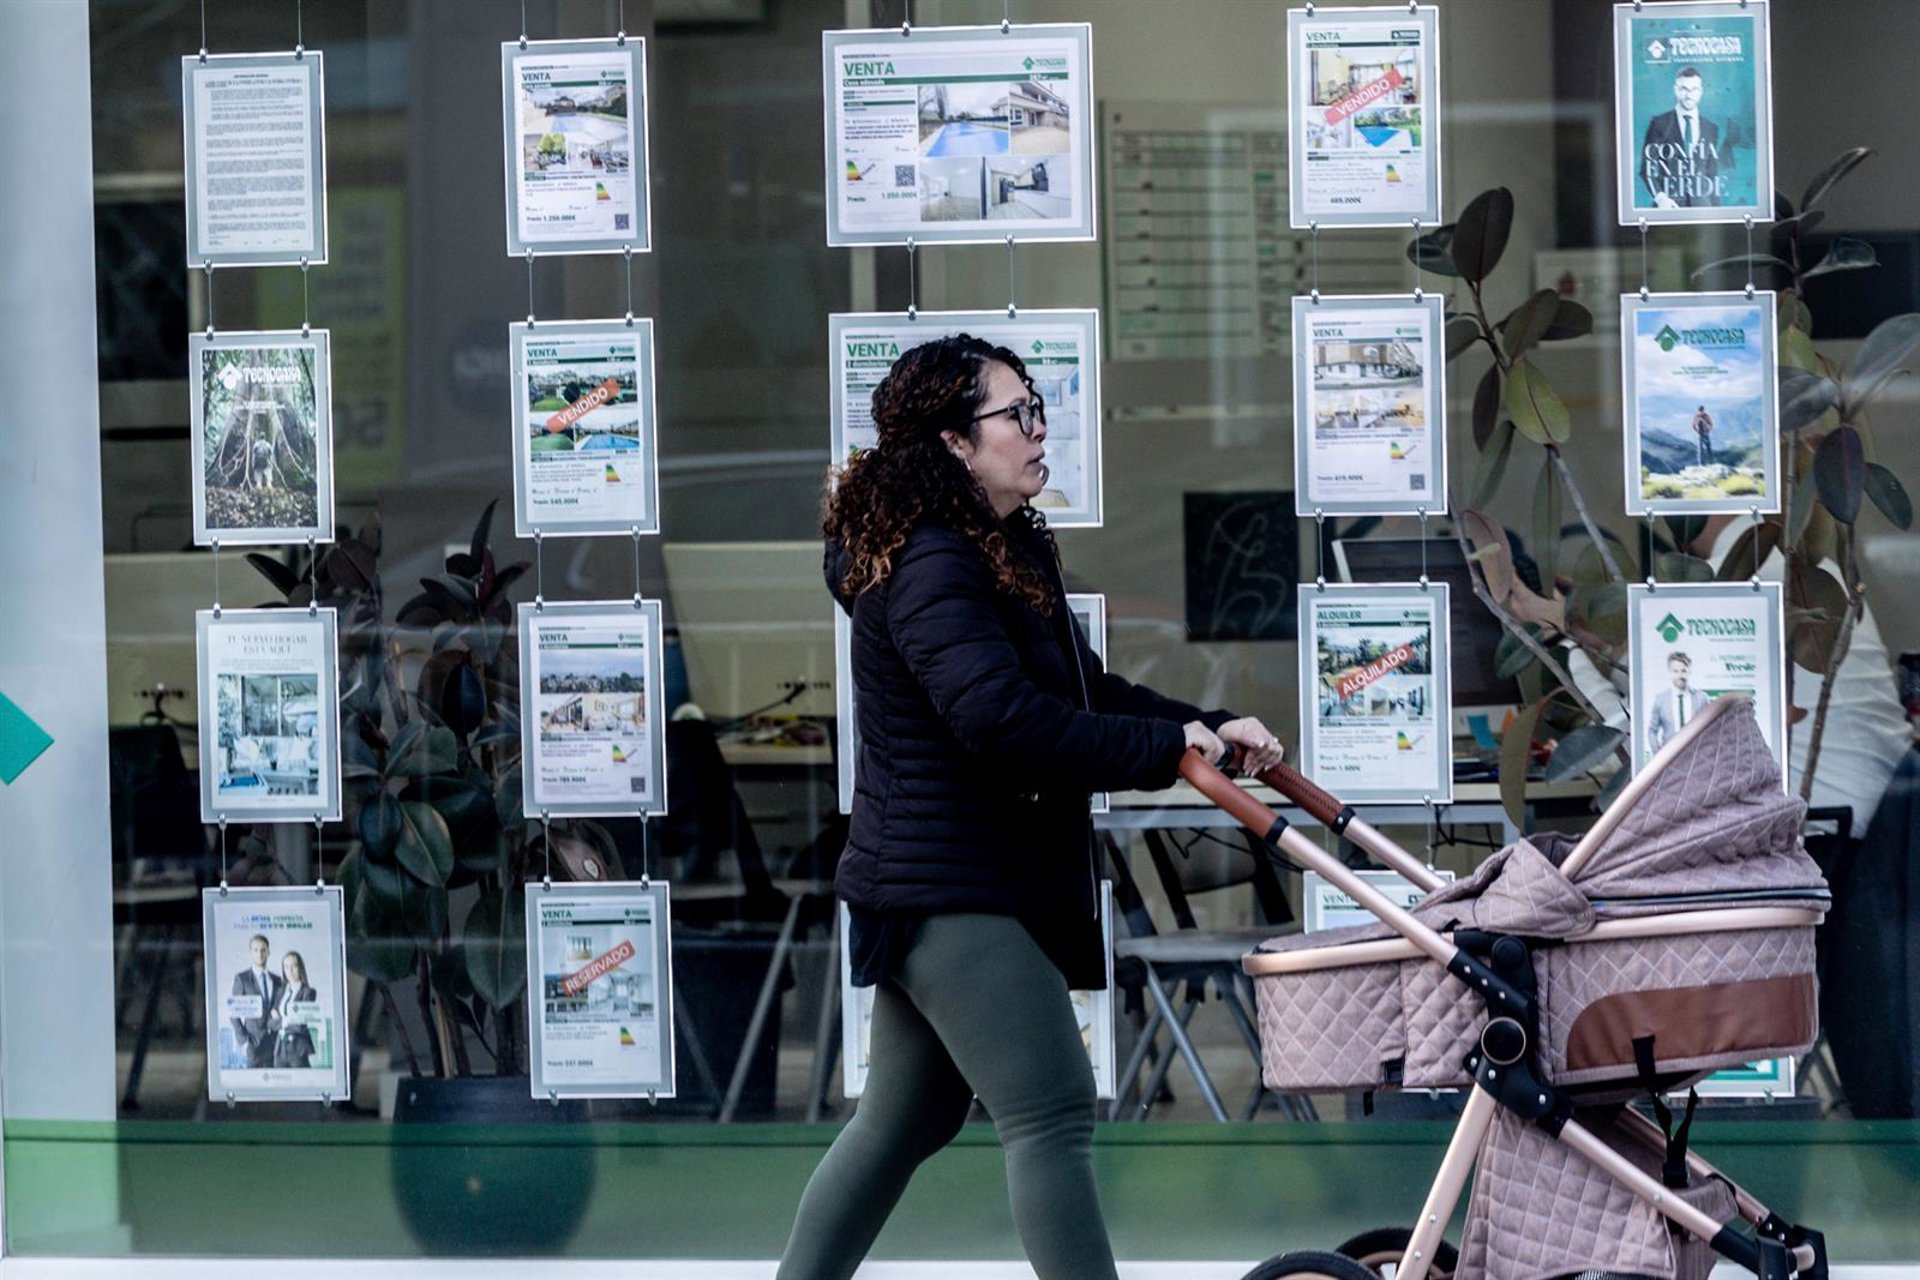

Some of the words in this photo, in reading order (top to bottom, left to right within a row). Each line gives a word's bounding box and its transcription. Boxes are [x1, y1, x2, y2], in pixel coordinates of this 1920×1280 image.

[1306, 32, 1341, 41] VENTA
[843, 61, 896, 76] VENTA
[522, 72, 551, 81] VENTA
[1335, 78, 1390, 116] VENDIDO
[1646, 176, 1729, 198] VERDE
[1312, 328, 1344, 337] VENTA
[527, 348, 558, 357] VENTA
[847, 342, 900, 357] VENTA
[557, 387, 609, 425] VENDIDO
[1317, 610, 1362, 620] ALQUILER
[1685, 618, 1756, 636] TECNOCASA
[539, 633, 569, 642] VENTA
[1342, 647, 1408, 697] ALQUILADO
[541, 909, 573, 919] VENTA
[565, 945, 631, 993] RESERVADO
